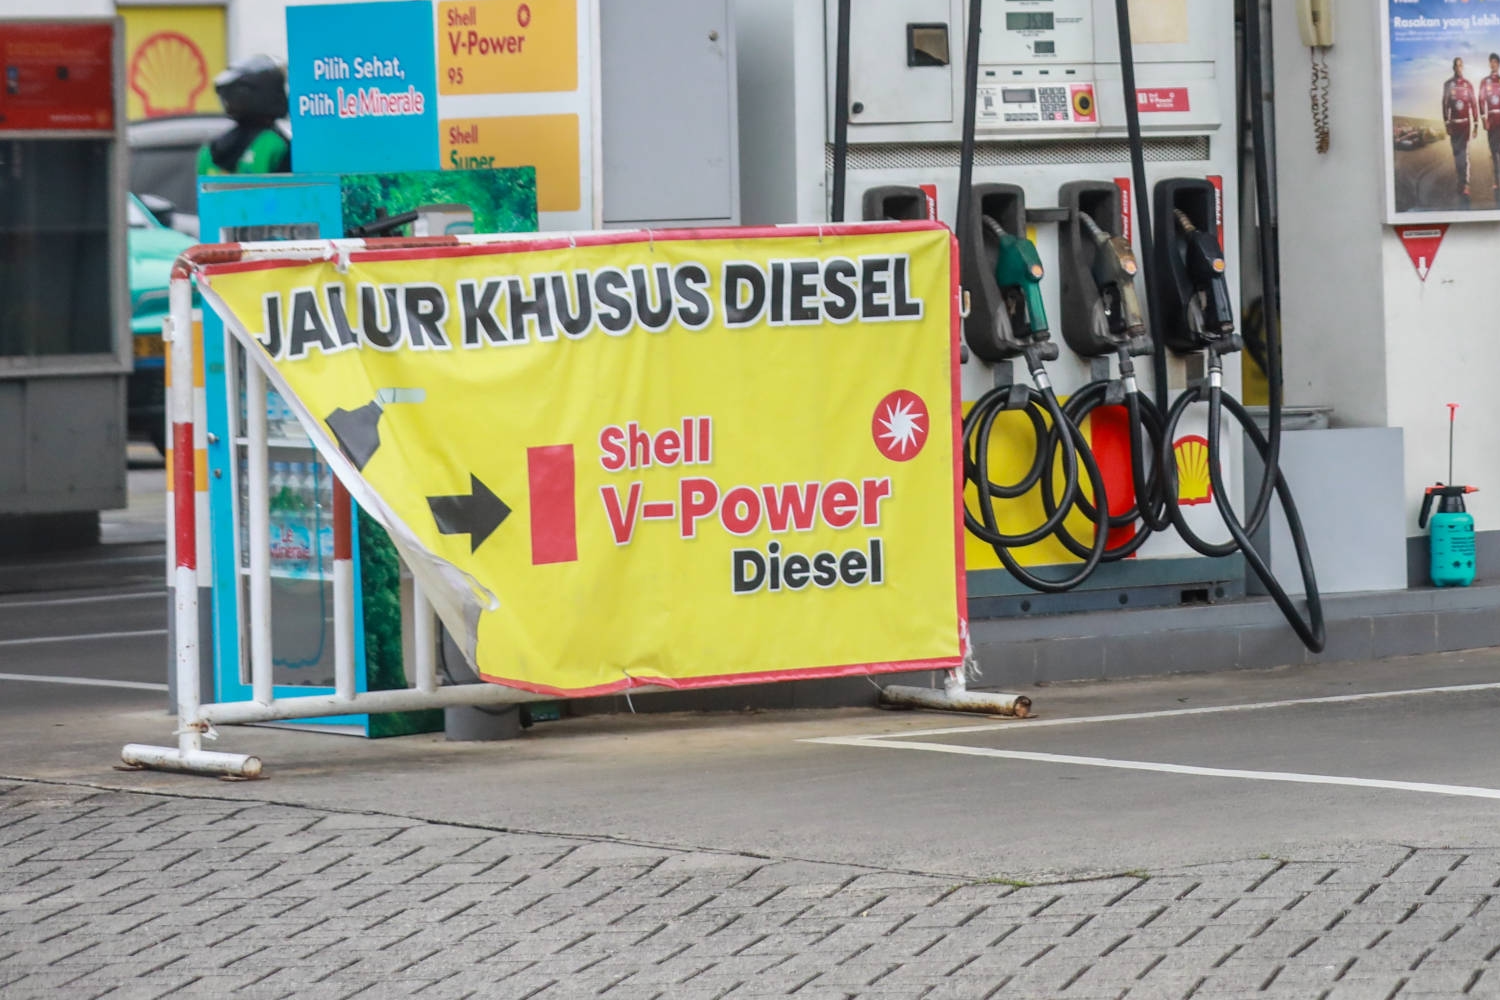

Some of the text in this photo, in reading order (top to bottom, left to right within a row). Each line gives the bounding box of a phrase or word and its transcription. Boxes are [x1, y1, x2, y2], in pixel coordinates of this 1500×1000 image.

[447, 7, 477, 27] Shell
[1394, 13, 1500, 30] Rasakan yang Lebih
[448, 31, 525, 56] V-Power
[314, 56, 405, 80] Pilih Sehat,
[447, 67, 463, 85] 95
[299, 85, 424, 117] Pilih Le Minerale
[449, 125, 478, 144] Shell
[450, 150, 495, 169] Super
[256, 255, 923, 361] JALUR KHUSUS DIESEL
[599, 416, 712, 473] Shell
[601, 476, 892, 546] V-Power
[732, 537, 883, 594] Diesel
